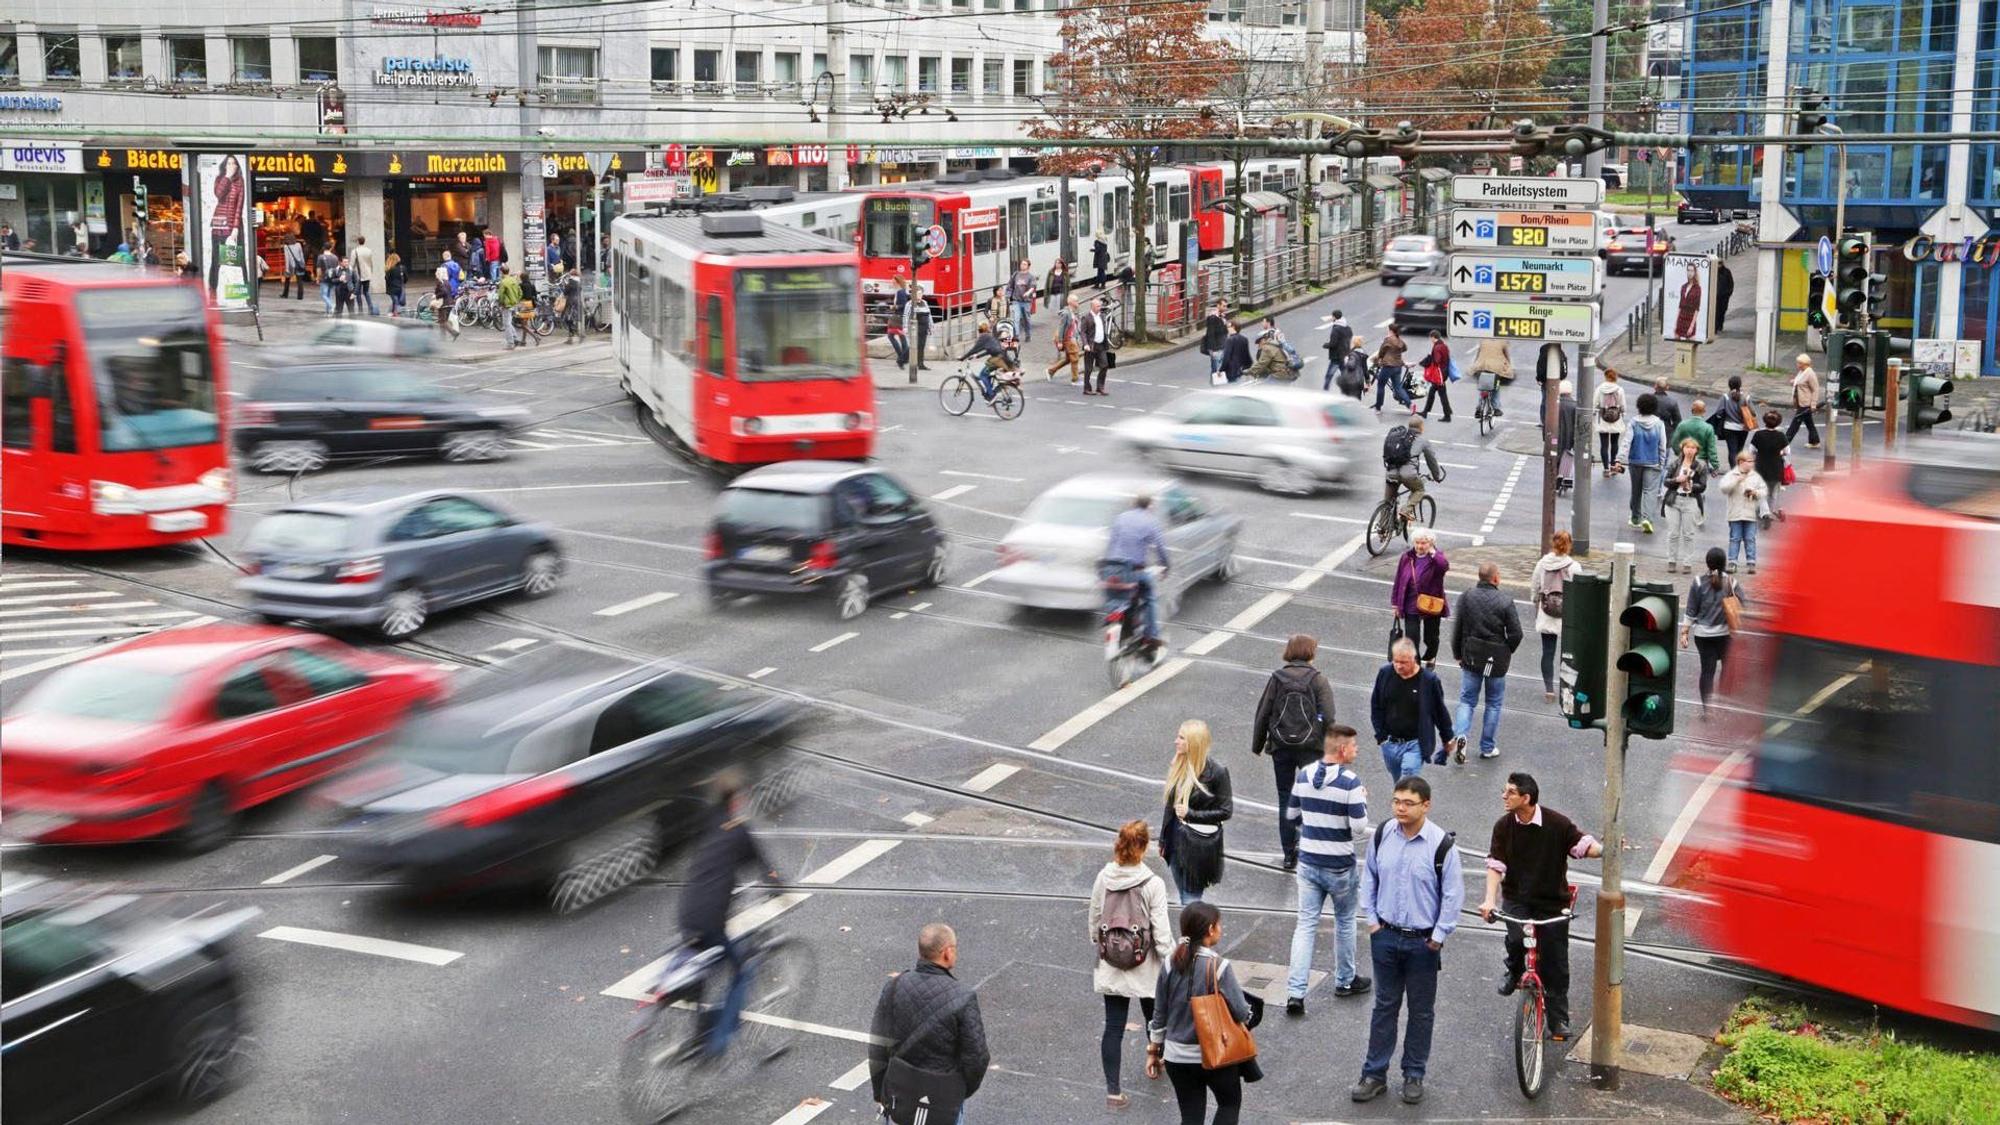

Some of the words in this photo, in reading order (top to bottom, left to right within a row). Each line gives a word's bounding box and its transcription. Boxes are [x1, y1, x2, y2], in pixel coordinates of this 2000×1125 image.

[385, 54, 473, 74] paracelsus
[250, 151, 316, 173] rzenich
[428, 152, 507, 173] Merzenich
[547, 164, 555, 177] 3
[1046, 184, 1055, 195] 4
[1482, 182, 1568, 199] Parkleitsystem
[1520, 214, 1570, 225] Dom/Rhein
[1512, 228, 1545, 246] 920
[1552, 236, 1567, 245] freie
[1568, 237, 1589, 246] Plätze
[1521, 261, 1564, 272] Neumarkt
[1666, 256, 1710, 269] MANGO
[1500, 273, 1543, 291] 1578
[1550, 282, 1566, 291] freie
[1567, 283, 1587, 292] Plätze
[1529, 305, 1554, 317] Ringe
[1498, 319, 1542, 337] 1480
[1549, 329, 1564, 337] freie
[1565, 330, 1586, 338] Plätze
